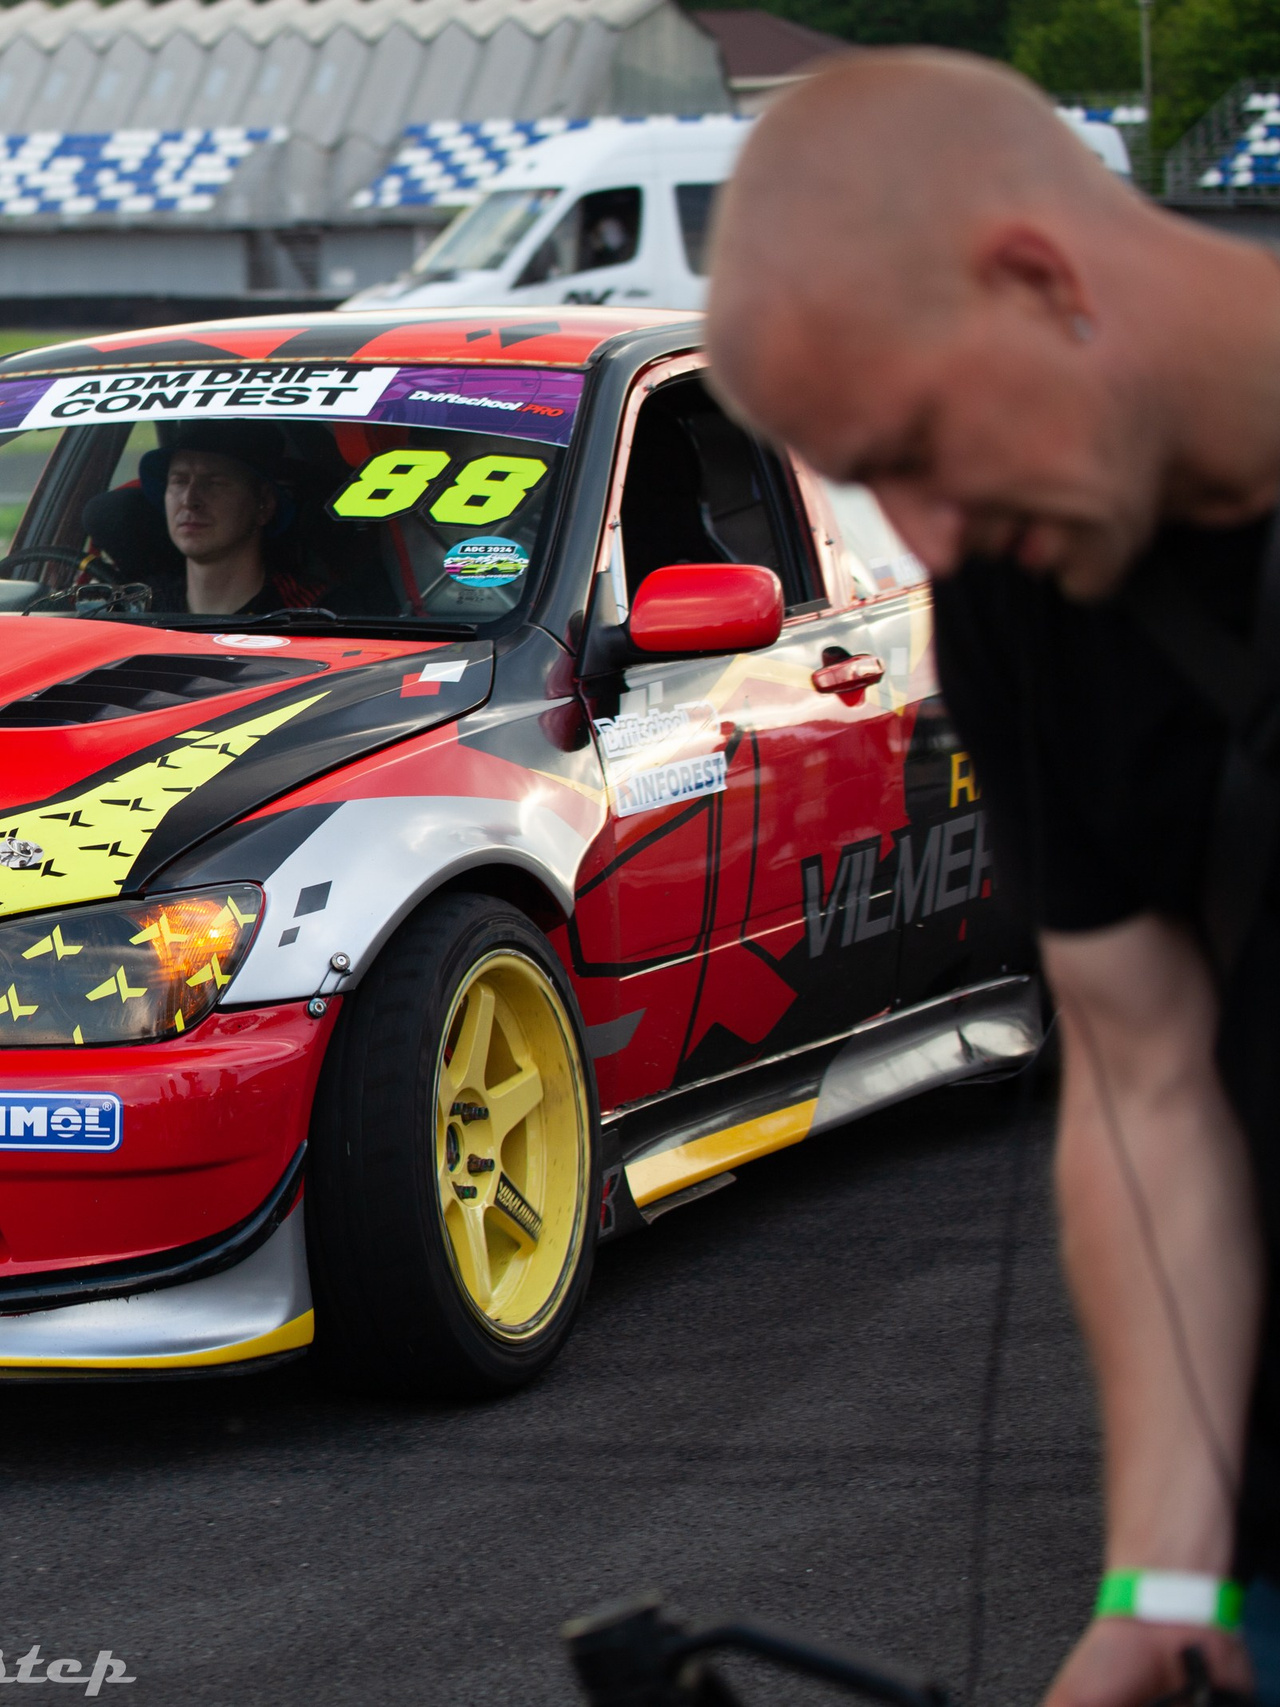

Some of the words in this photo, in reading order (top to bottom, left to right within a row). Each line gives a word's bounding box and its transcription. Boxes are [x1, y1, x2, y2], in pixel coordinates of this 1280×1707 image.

[65, 372, 197, 397] ADM
[200, 367, 373, 387] DRIFT
[50, 386, 360, 418] CONTEST
[332, 449, 549, 526] 88
